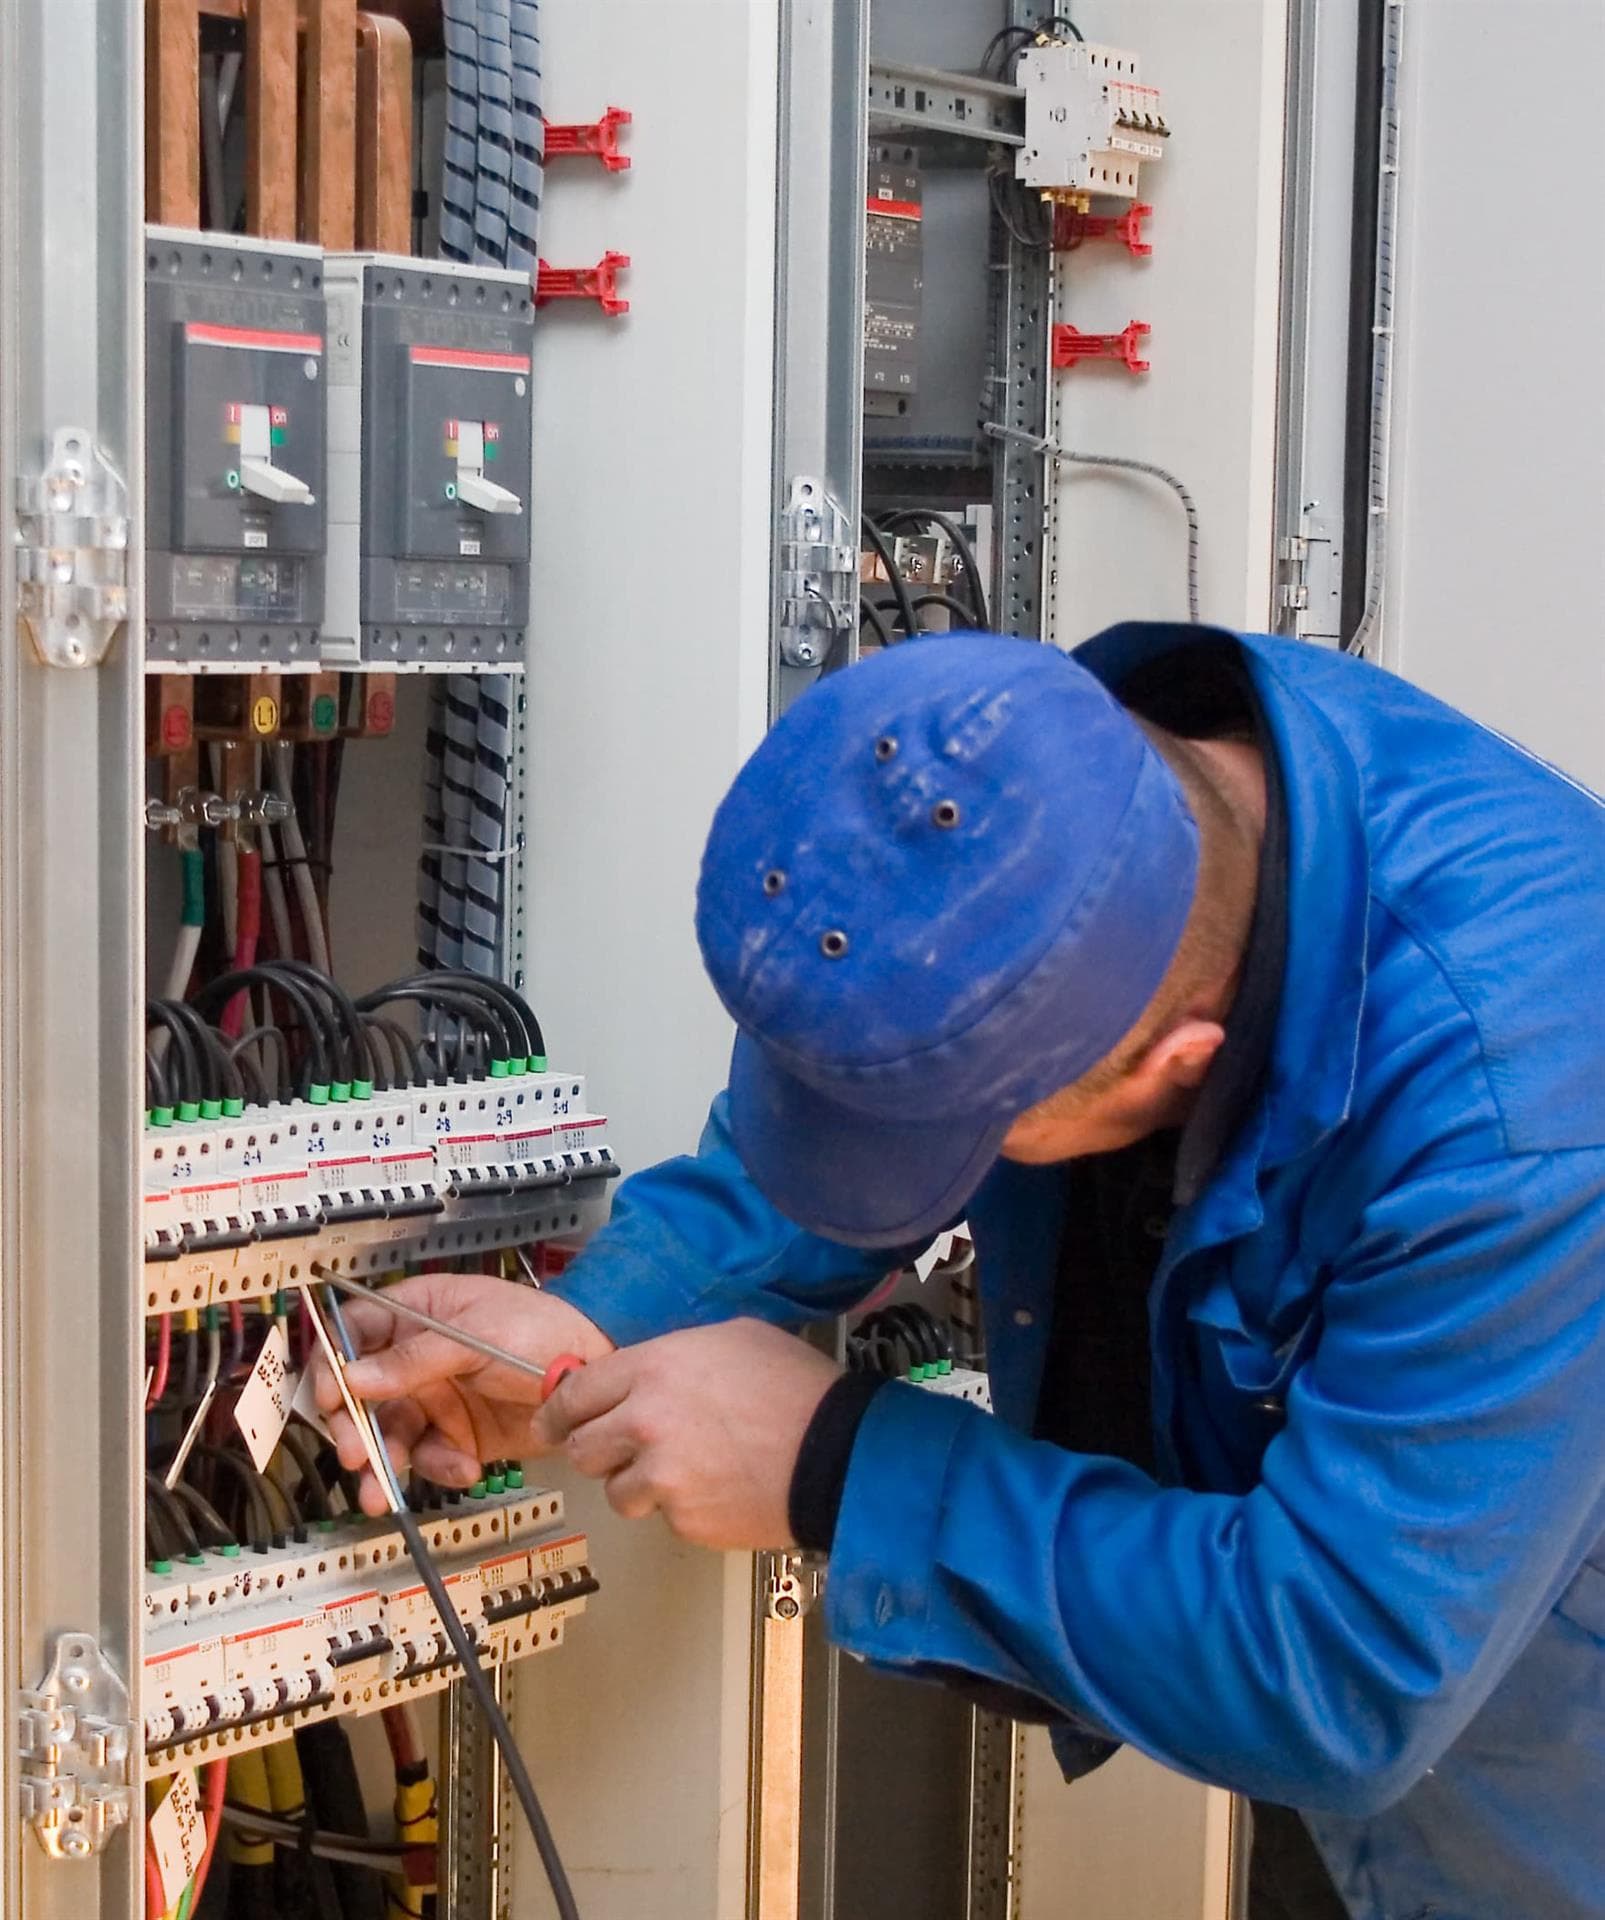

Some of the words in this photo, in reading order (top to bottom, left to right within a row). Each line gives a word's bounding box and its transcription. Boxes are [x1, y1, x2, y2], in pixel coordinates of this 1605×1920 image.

[273, 411, 288, 425] on
[486, 426, 499, 441] on
[257, 705, 274, 726] L1
[436, 1116, 451, 1132] 2-8
[497, 1110, 512, 1126] 2-9
[308, 1137, 325, 1152] 2-5
[373, 1132, 390, 1148] 2-6
[172, 1162, 191, 1177] 2-3
